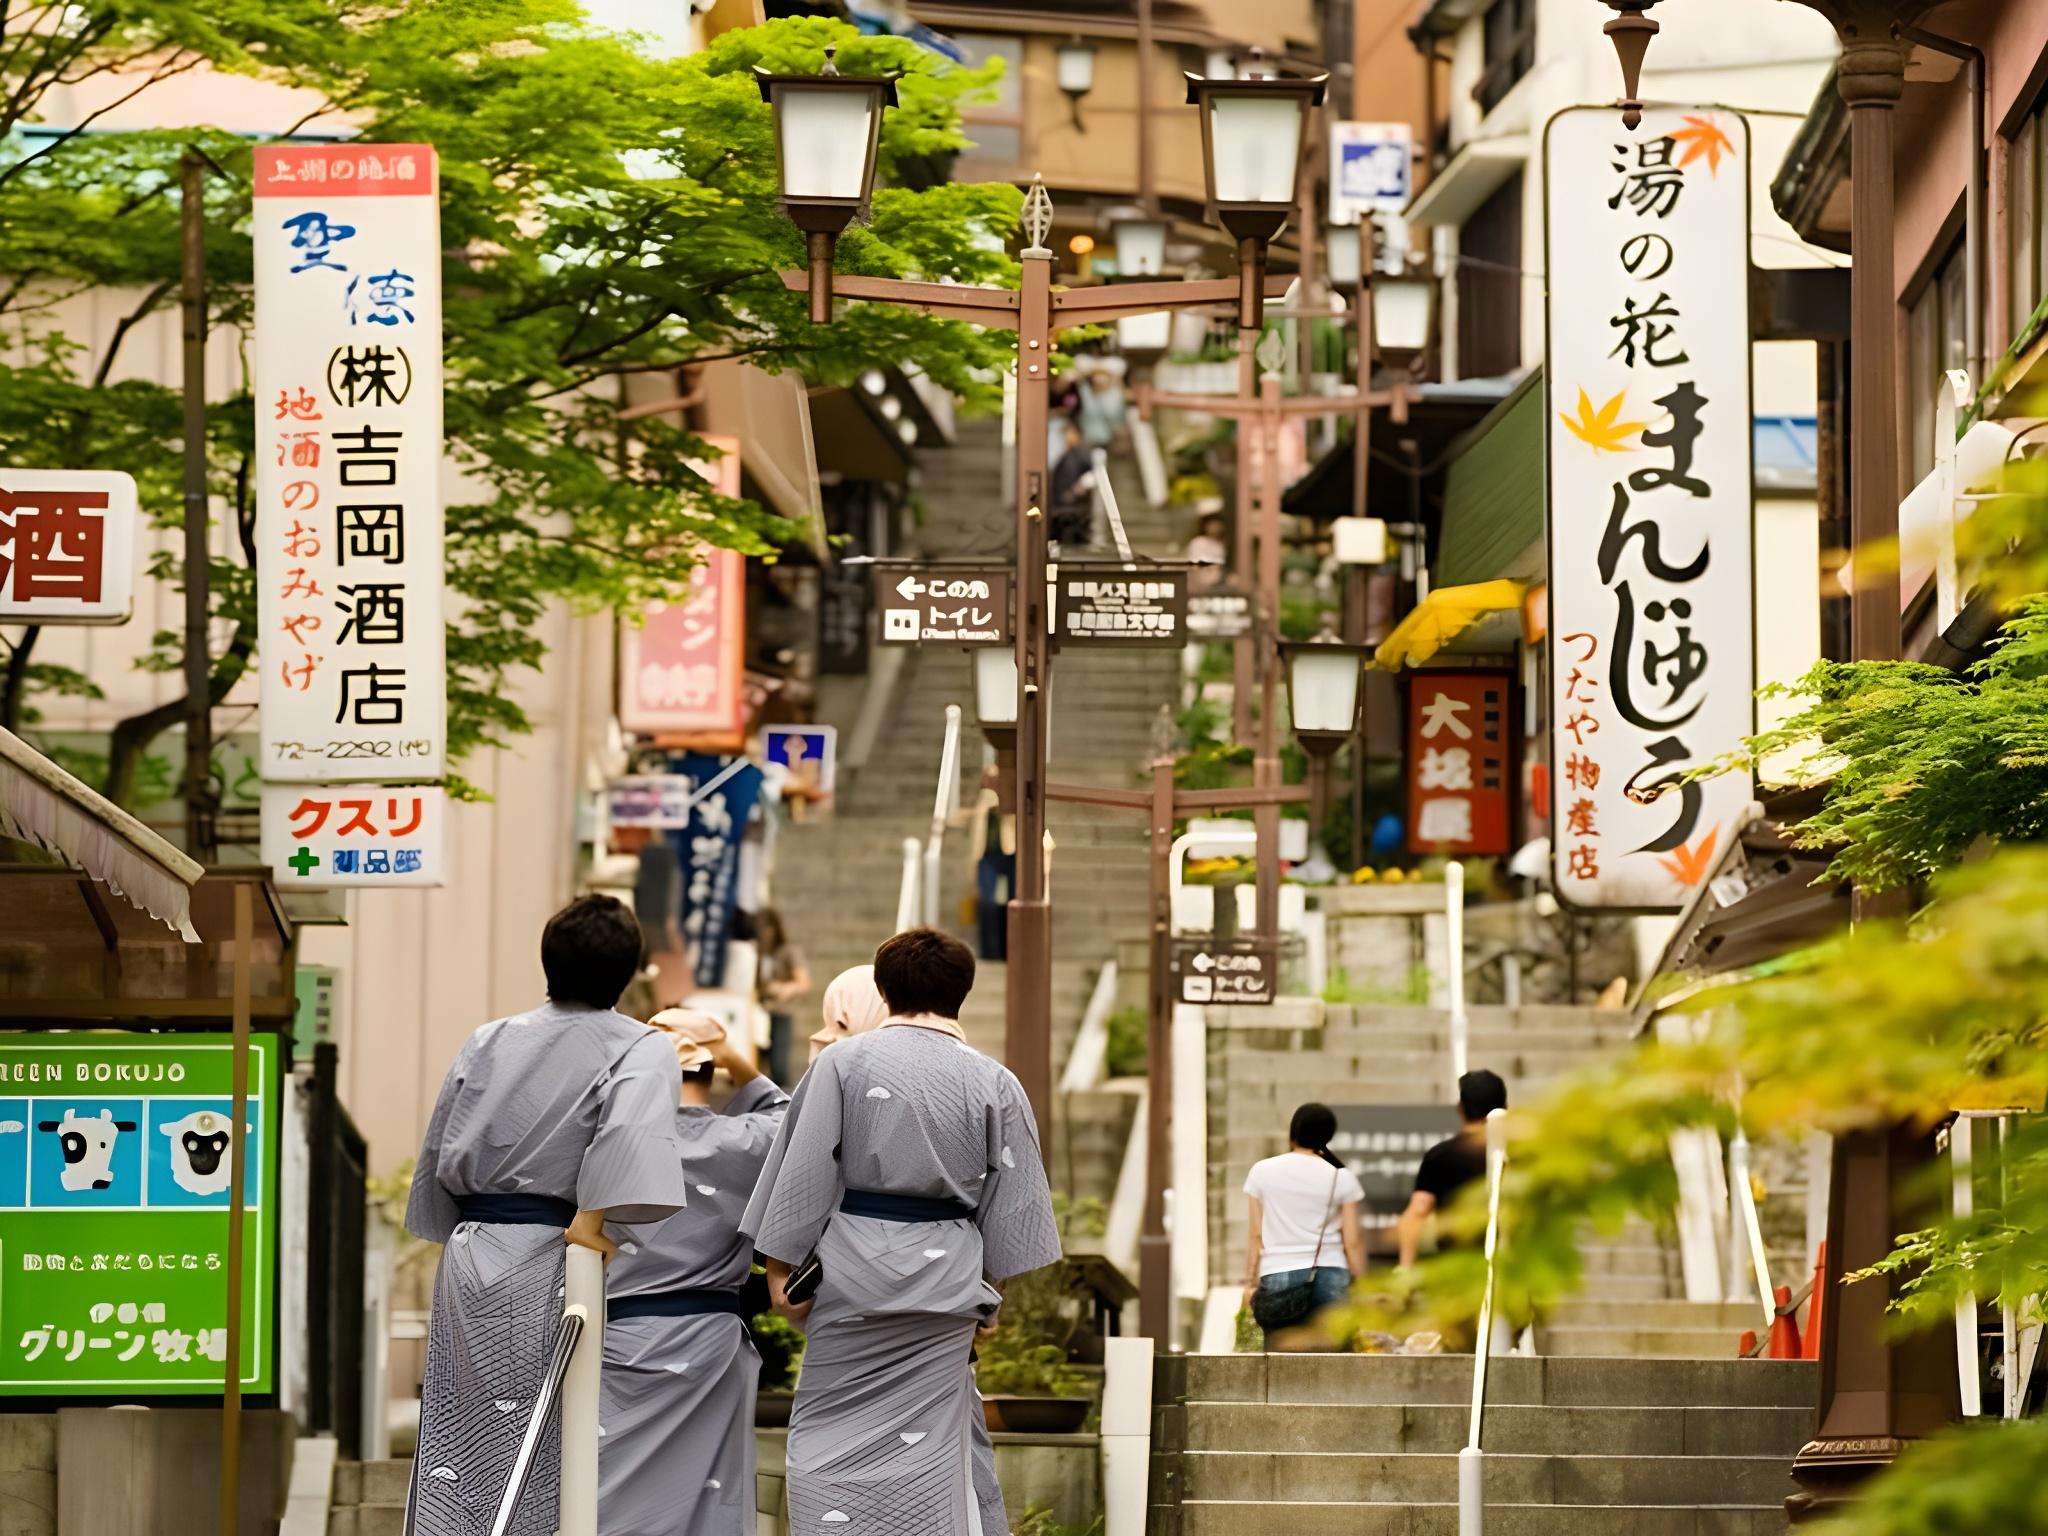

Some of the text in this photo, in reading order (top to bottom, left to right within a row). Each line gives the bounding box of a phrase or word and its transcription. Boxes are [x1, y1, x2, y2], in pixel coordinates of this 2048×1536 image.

[0, 487, 109, 603] 酒
[274, 386, 324, 692] 地酒のおみやげ
[929, 606, 993, 626] トイレ
[1561, 633, 1601, 881] つたや物産店
[288, 798, 422, 839] クスリ
